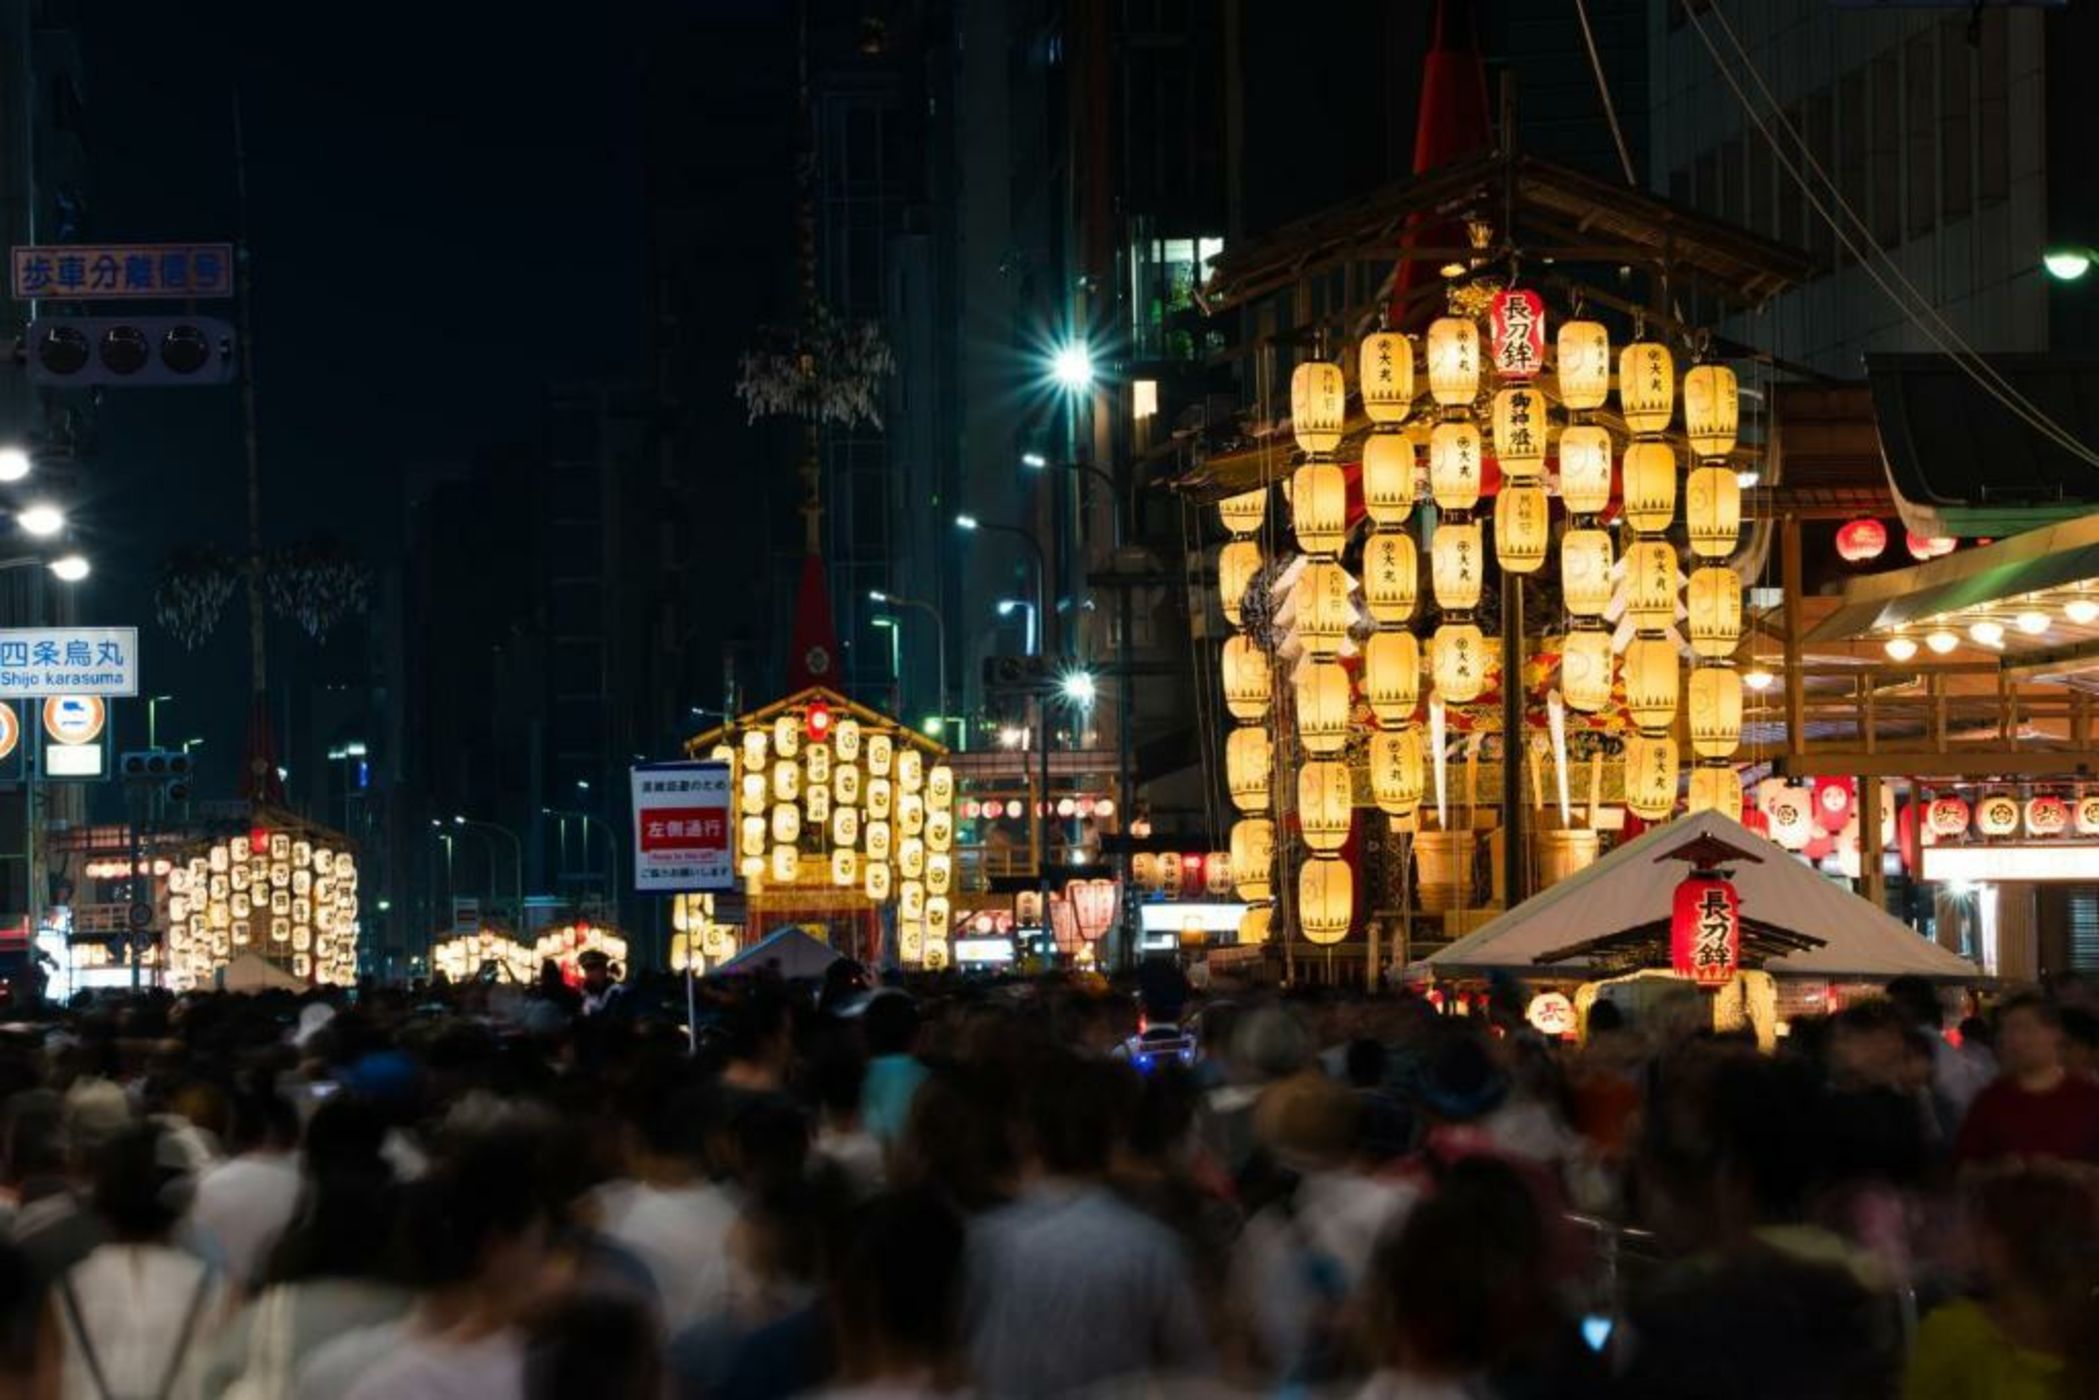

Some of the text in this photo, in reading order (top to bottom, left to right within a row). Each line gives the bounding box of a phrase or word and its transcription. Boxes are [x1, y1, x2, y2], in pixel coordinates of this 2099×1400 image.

[1504, 296, 1533, 369] 長刀鉾
[1, 640, 124, 667] 四条烏丸
[1, 672, 124, 688] Shijo karasuma
[1699, 891, 1730, 968] 長刀鉾
